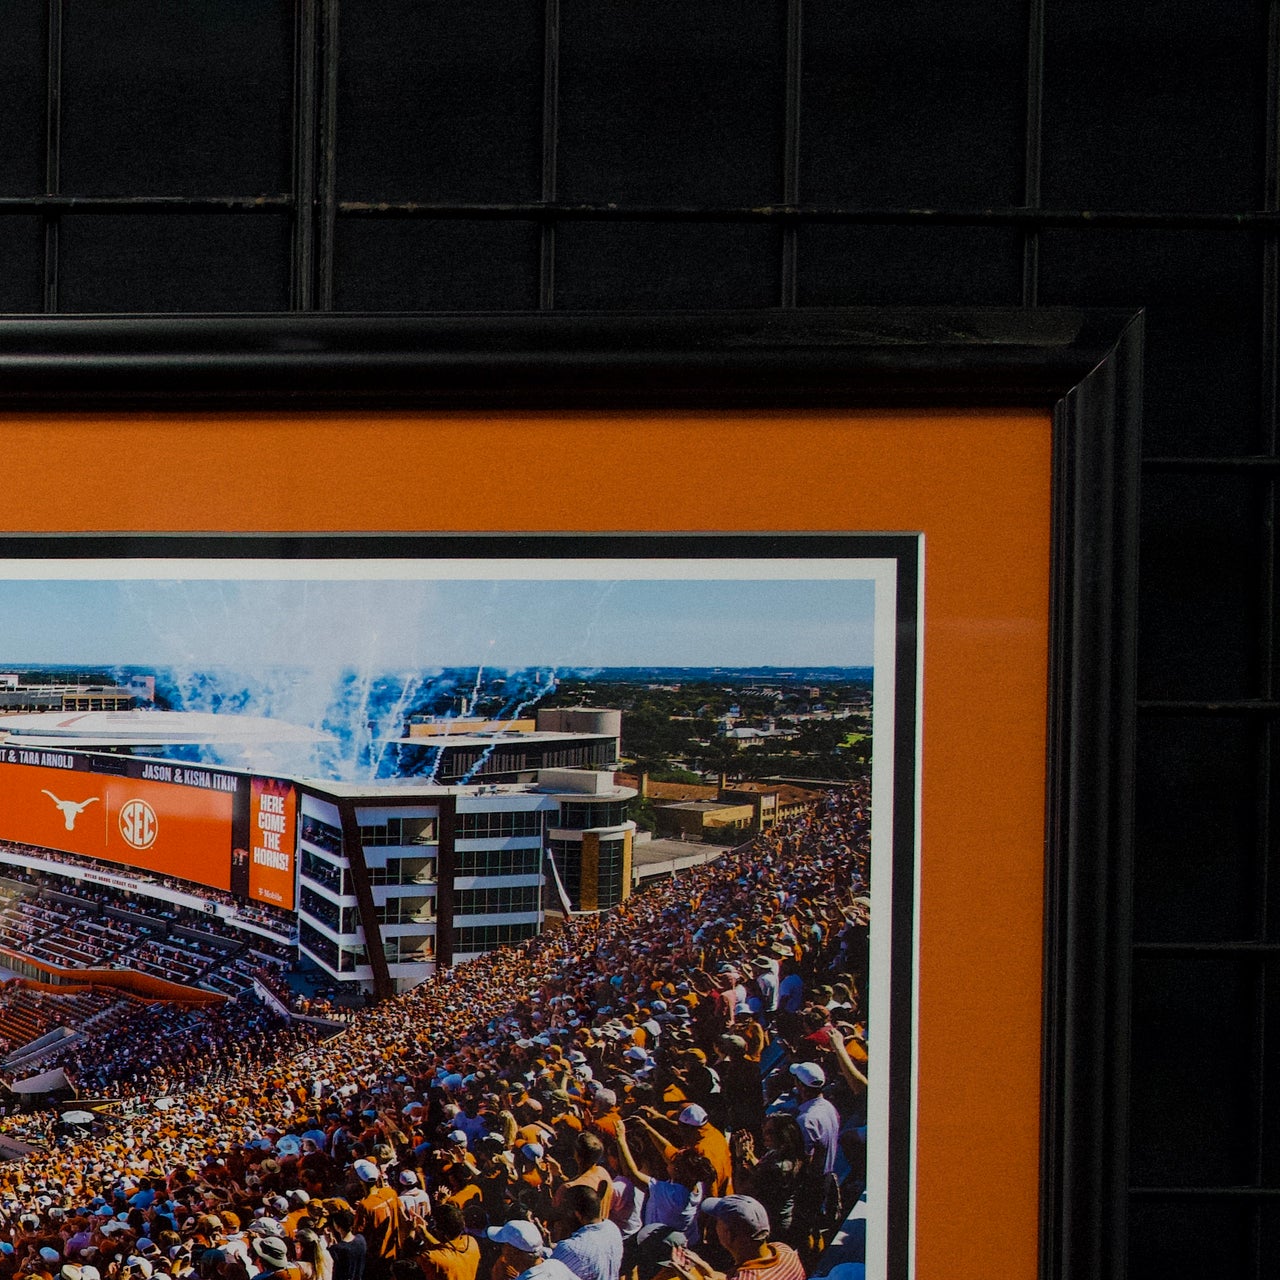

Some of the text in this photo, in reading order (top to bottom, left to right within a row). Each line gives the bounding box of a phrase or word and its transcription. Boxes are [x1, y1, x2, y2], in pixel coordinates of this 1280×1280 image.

[8, 750, 17, 764] &
[19, 750, 40, 765] TARA
[41, 753, 74, 769] ARNOLD
[142, 764, 238, 792] JASON & KISHA ITKIN
[260, 793, 284, 814] HERE
[122, 802, 156, 846] SEC
[258, 811, 286, 833] COME
[263, 830, 280, 850] THE
[253, 846, 289, 872] HORNS!
